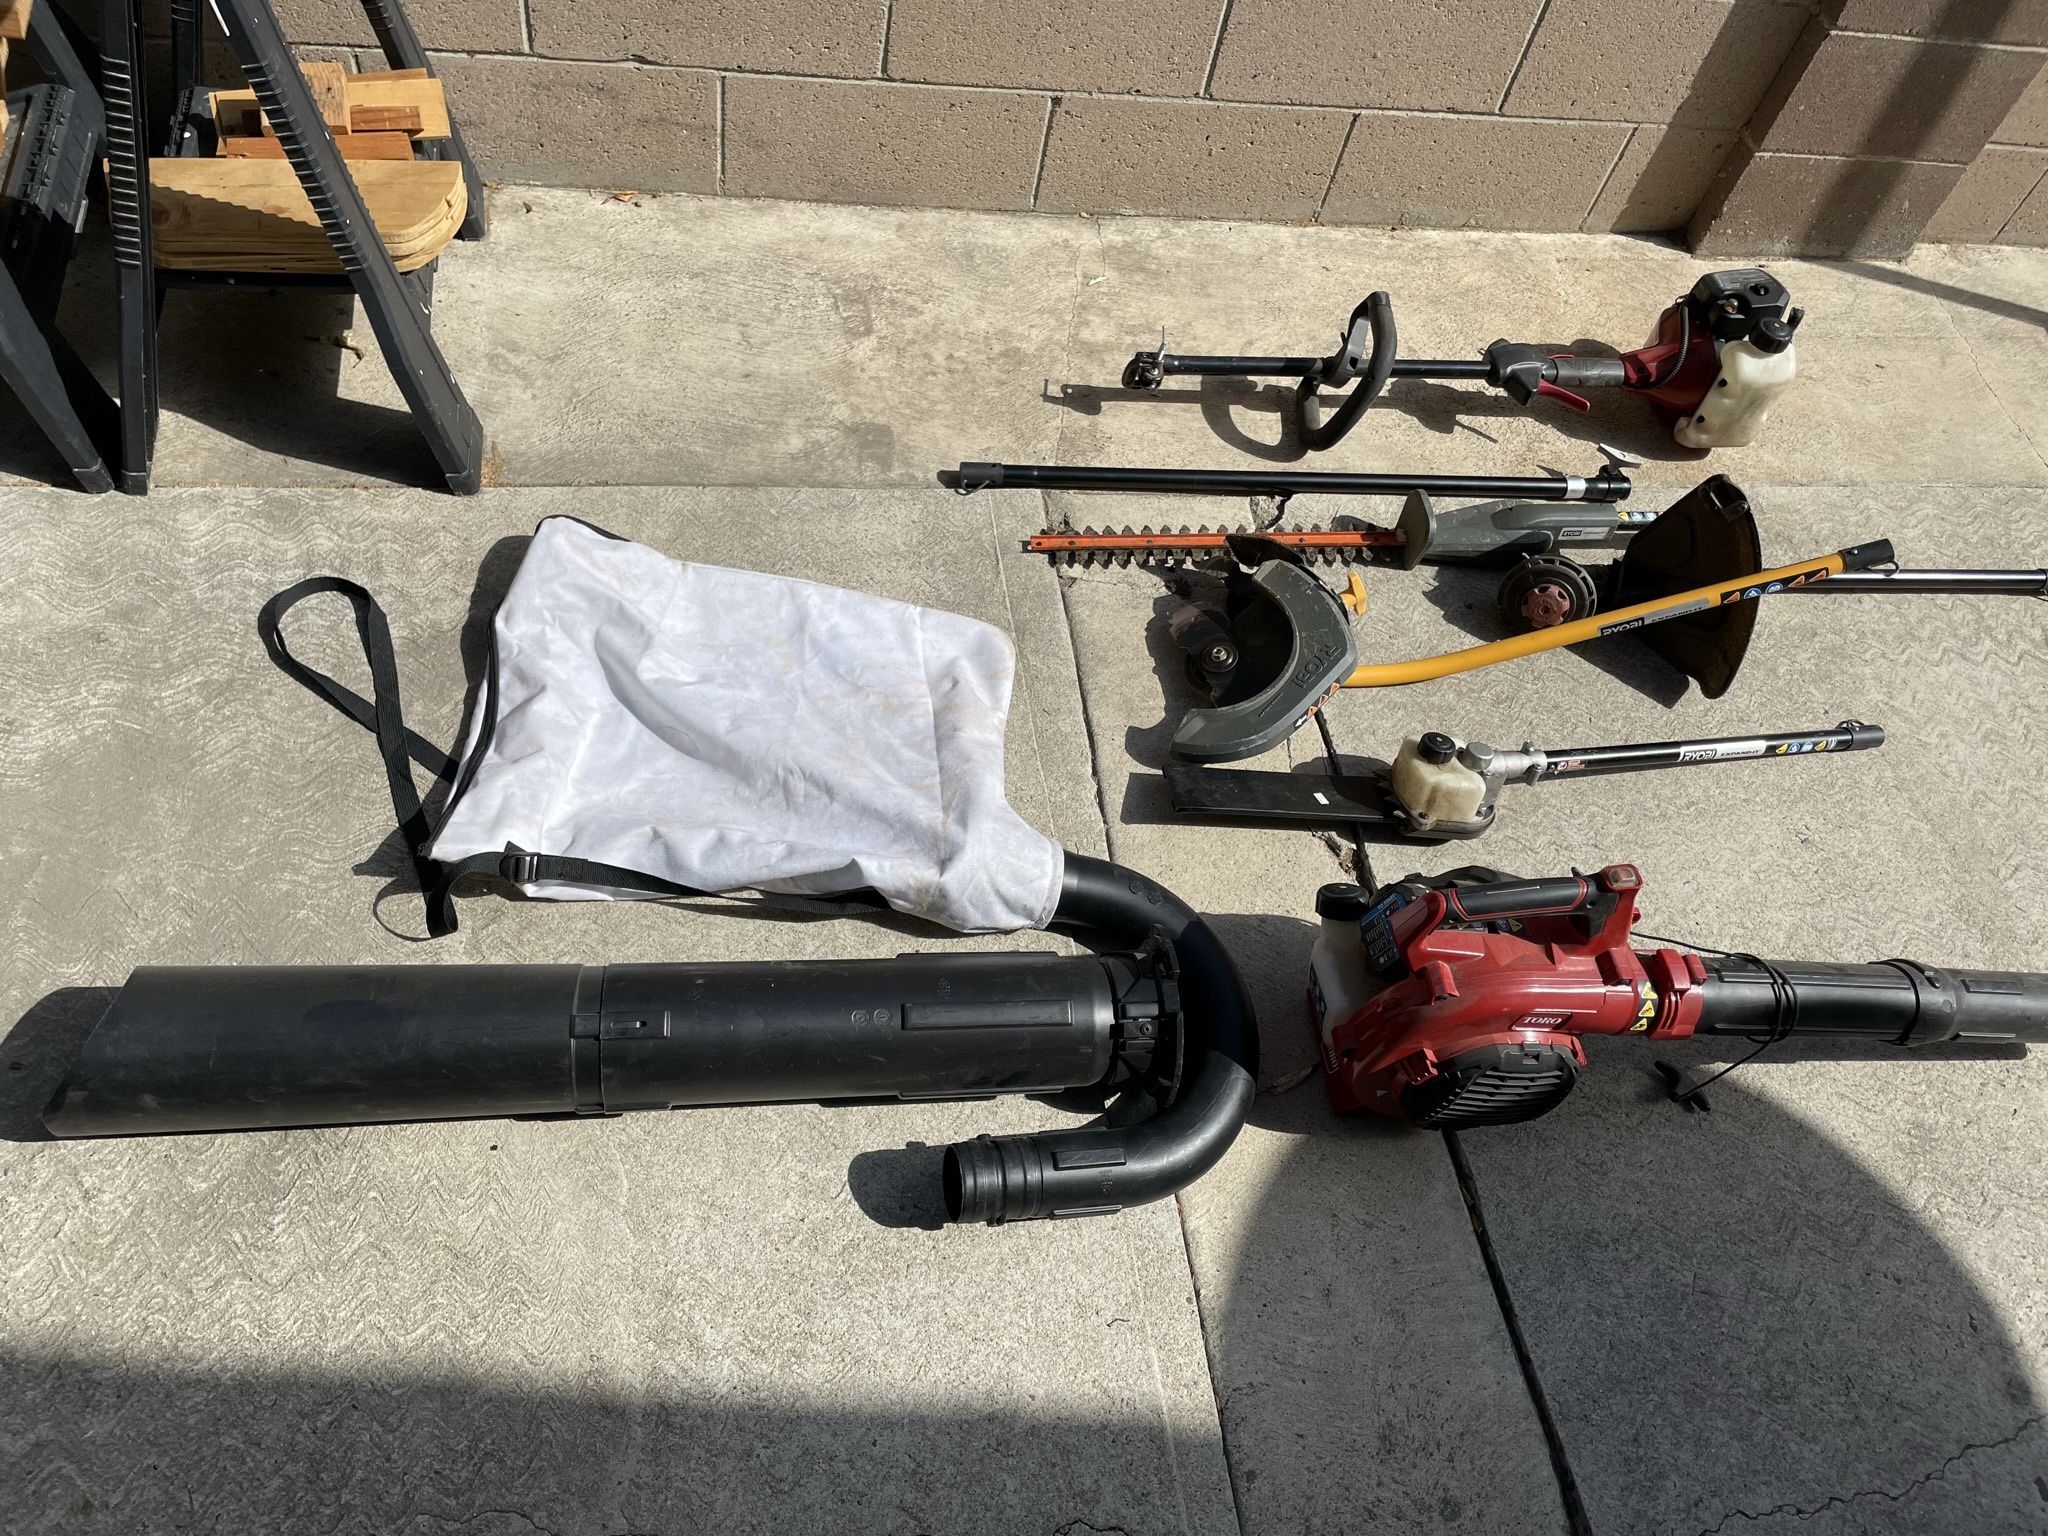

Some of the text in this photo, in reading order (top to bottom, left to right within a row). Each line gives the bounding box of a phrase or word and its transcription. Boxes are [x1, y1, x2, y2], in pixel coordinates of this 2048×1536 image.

[1602, 620, 1642, 636] RYOBI
[1291, 644, 1341, 689] RYOBI
[1683, 750, 1716, 761] RYOBI
[1522, 1016, 1562, 1025] TORO
